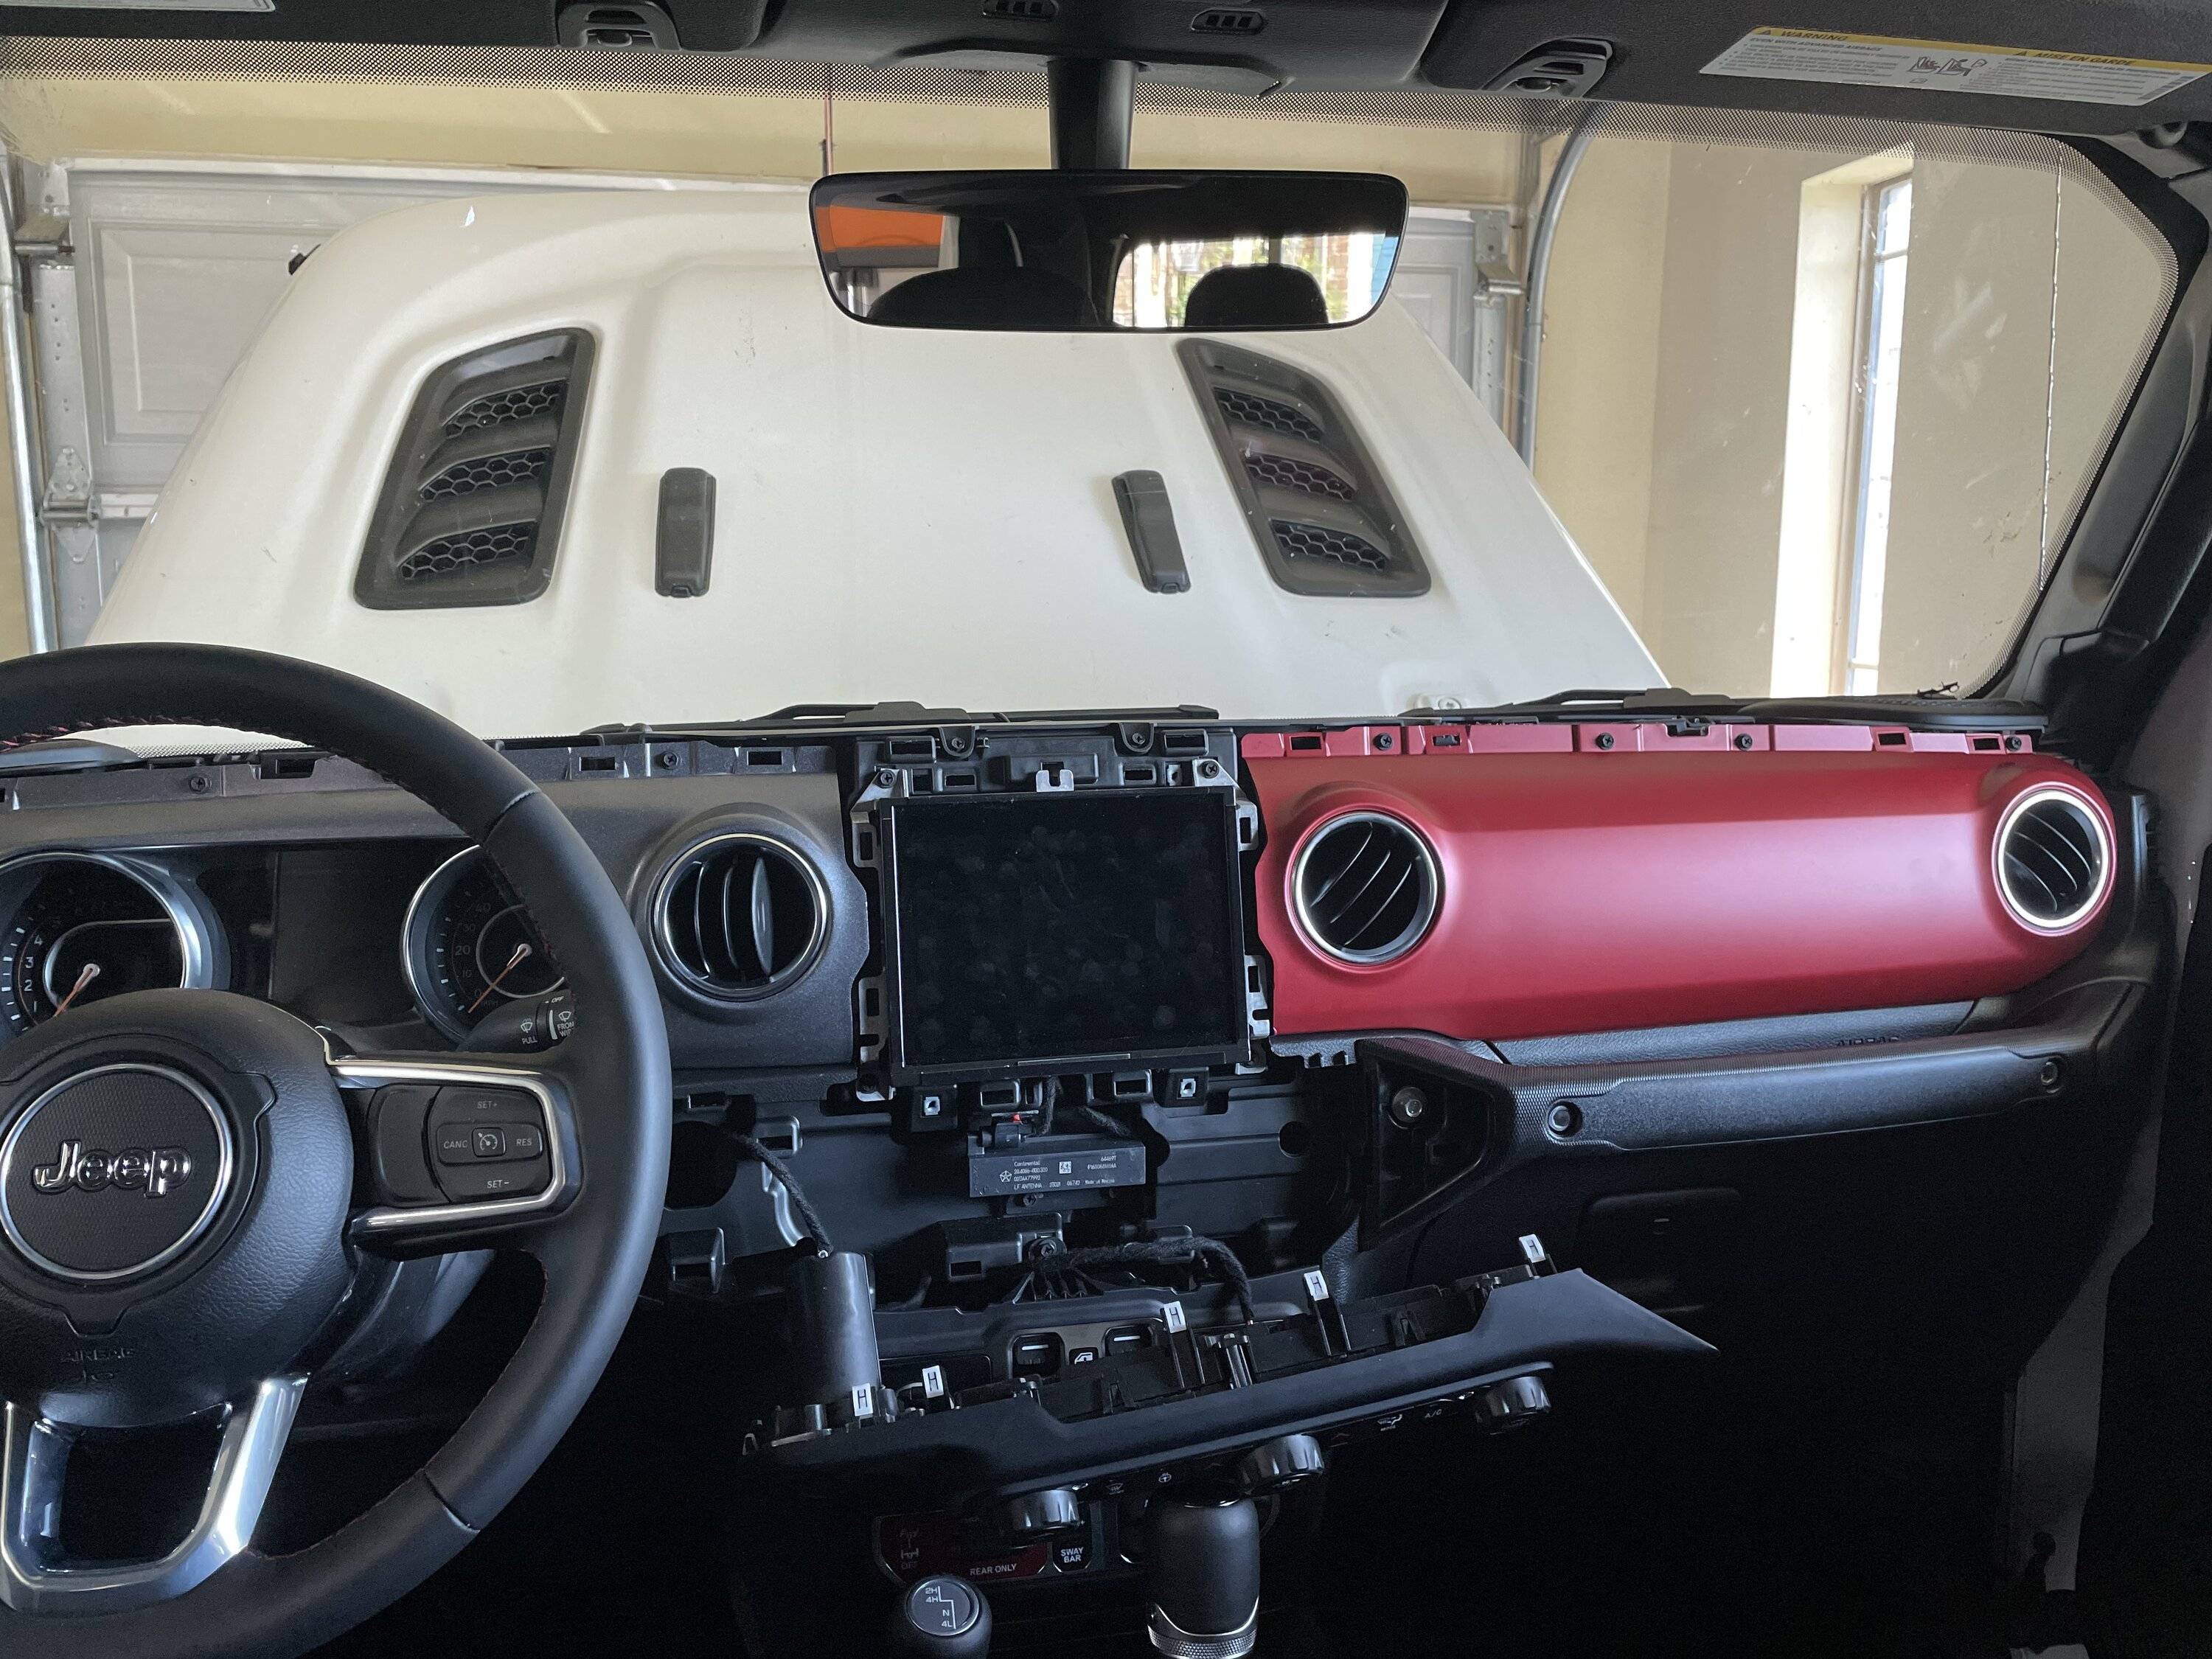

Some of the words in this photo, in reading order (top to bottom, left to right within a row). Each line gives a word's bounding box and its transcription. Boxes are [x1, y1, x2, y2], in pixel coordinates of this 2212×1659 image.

[1781, 31, 1848, 41] WARNING
[2034, 52, 2070, 60] MISE
[2090, 57, 2137, 66] GARDE
[33, 934, 44, 946] 4
[455, 945, 471, 956] 20
[25, 956, 34, 969] 3
[24, 979, 32, 992] 2
[551, 995, 565, 1004] OFF
[557, 1020, 574, 1031] FRON
[521, 1036, 538, 1045] PULL
[443, 1140, 468, 1150] CANC
[515, 1138, 532, 1147] RES
[32, 1139, 192, 1197] Jeep
[1169, 1307, 1181, 1326] H
[928, 1371, 939, 1391] H
[858, 1389, 868, 1409] H
[1424, 1408, 1442, 1419] A/C
[1060, 1546, 1085, 1557] SWAY
[1063, 1554, 1082, 1564] BAR
[970, 1565, 995, 1576] REAR
[995, 1562, 1018, 1573] ONLY
[925, 1587, 938, 1595] 2H
[925, 1595, 939, 1603] 4H
[942, 1609, 950, 1617] N
